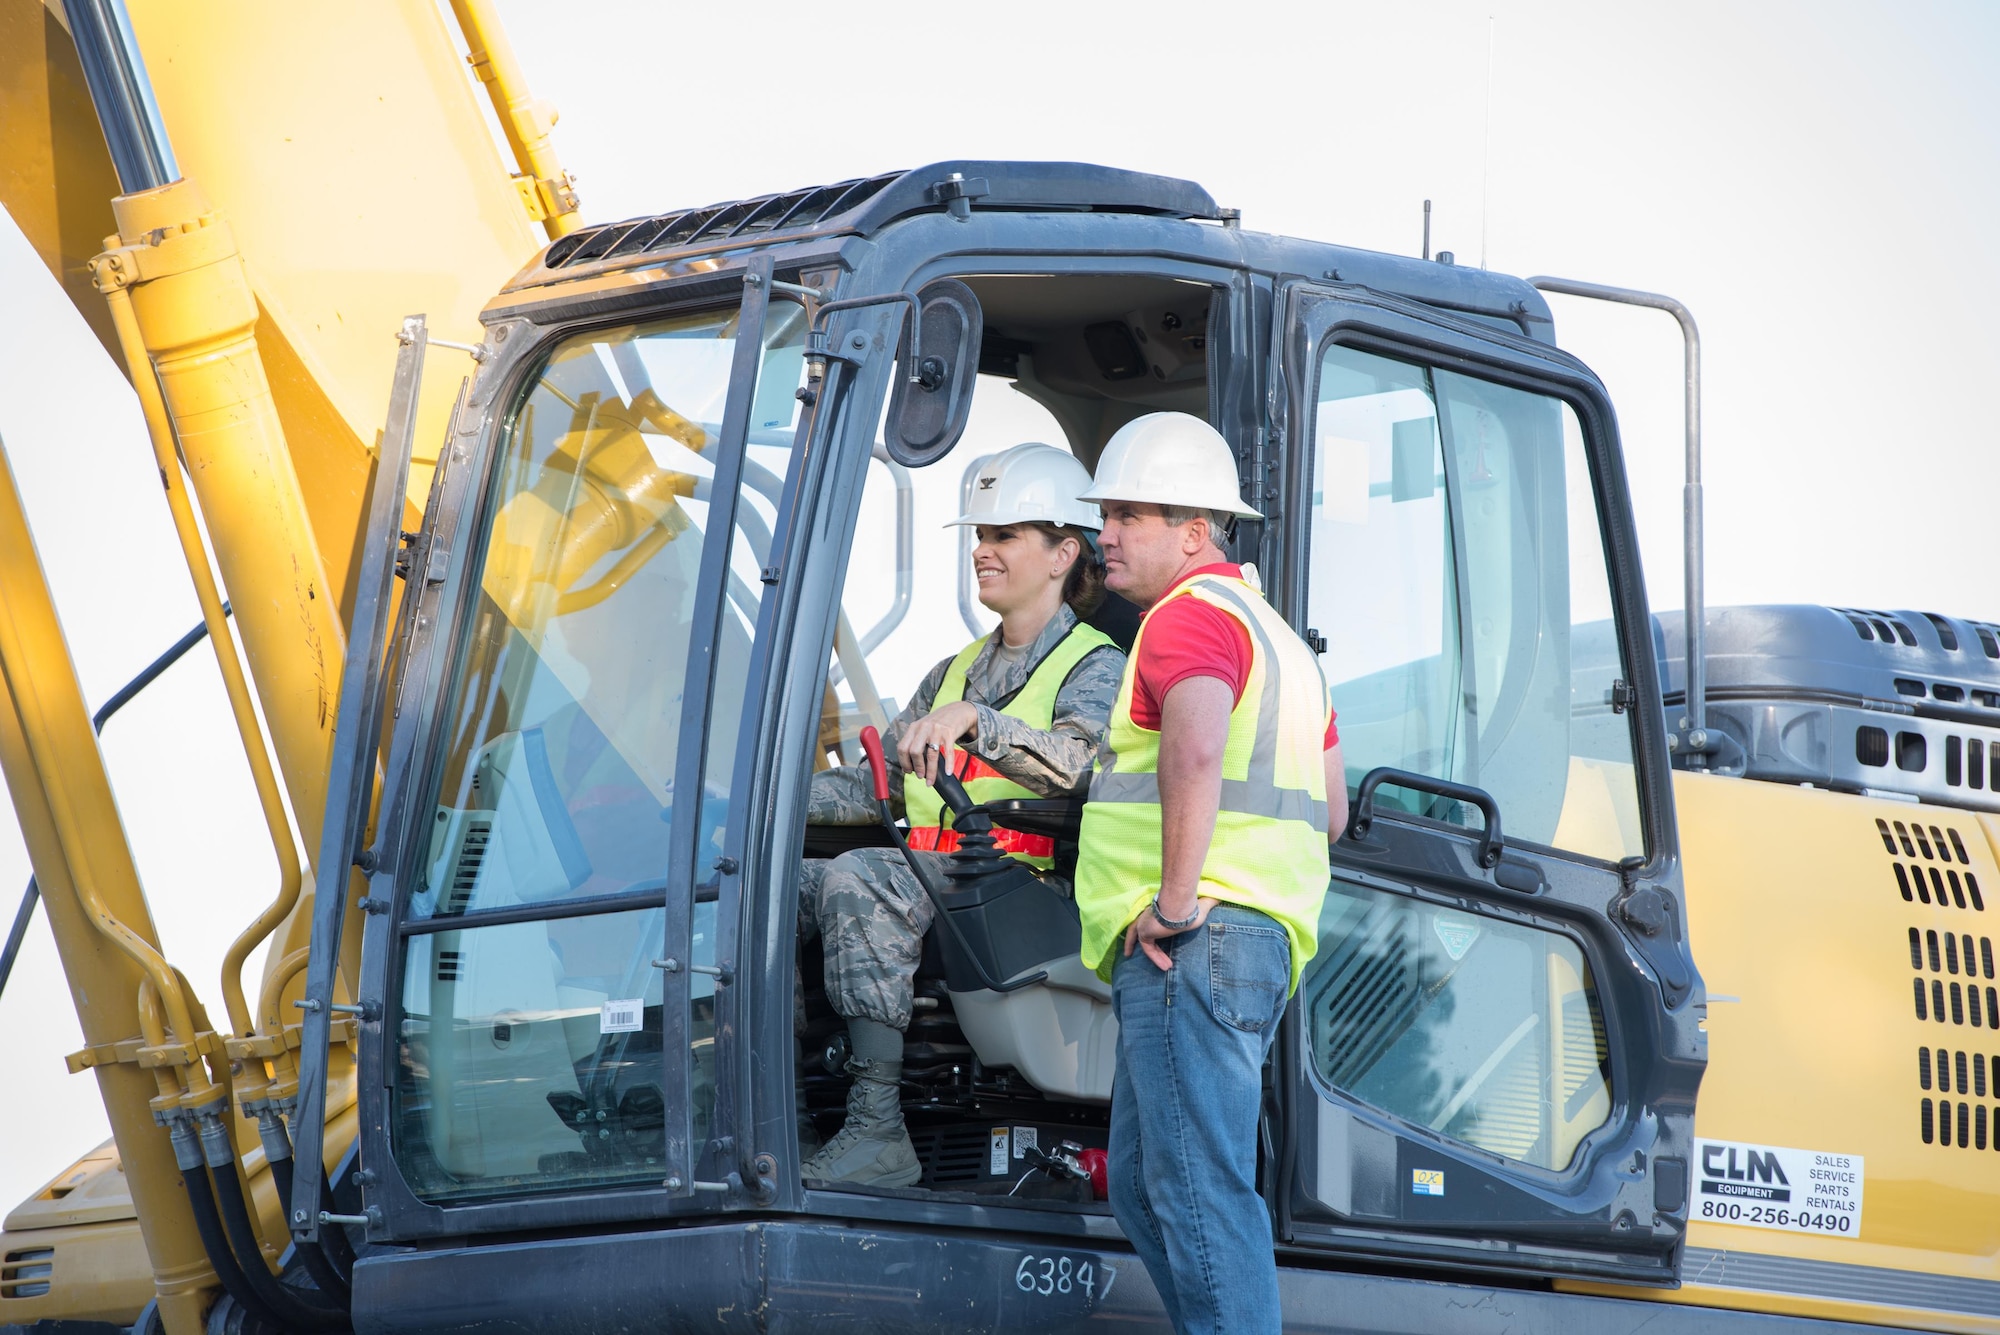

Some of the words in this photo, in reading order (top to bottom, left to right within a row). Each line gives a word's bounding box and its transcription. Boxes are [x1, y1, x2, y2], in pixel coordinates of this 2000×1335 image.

[1702, 1144, 1791, 1187] CLM
[1815, 1155, 1850, 1169] SALES
[1809, 1168, 1856, 1183] SERVICE
[1717, 1183, 1774, 1199] EQUIPMENT
[1814, 1183, 1849, 1197] PARTS
[1806, 1197, 1856, 1212] RENTALS
[1702, 1201, 1851, 1232] 800-256-0490
[1015, 1254, 1118, 1300] 63847
